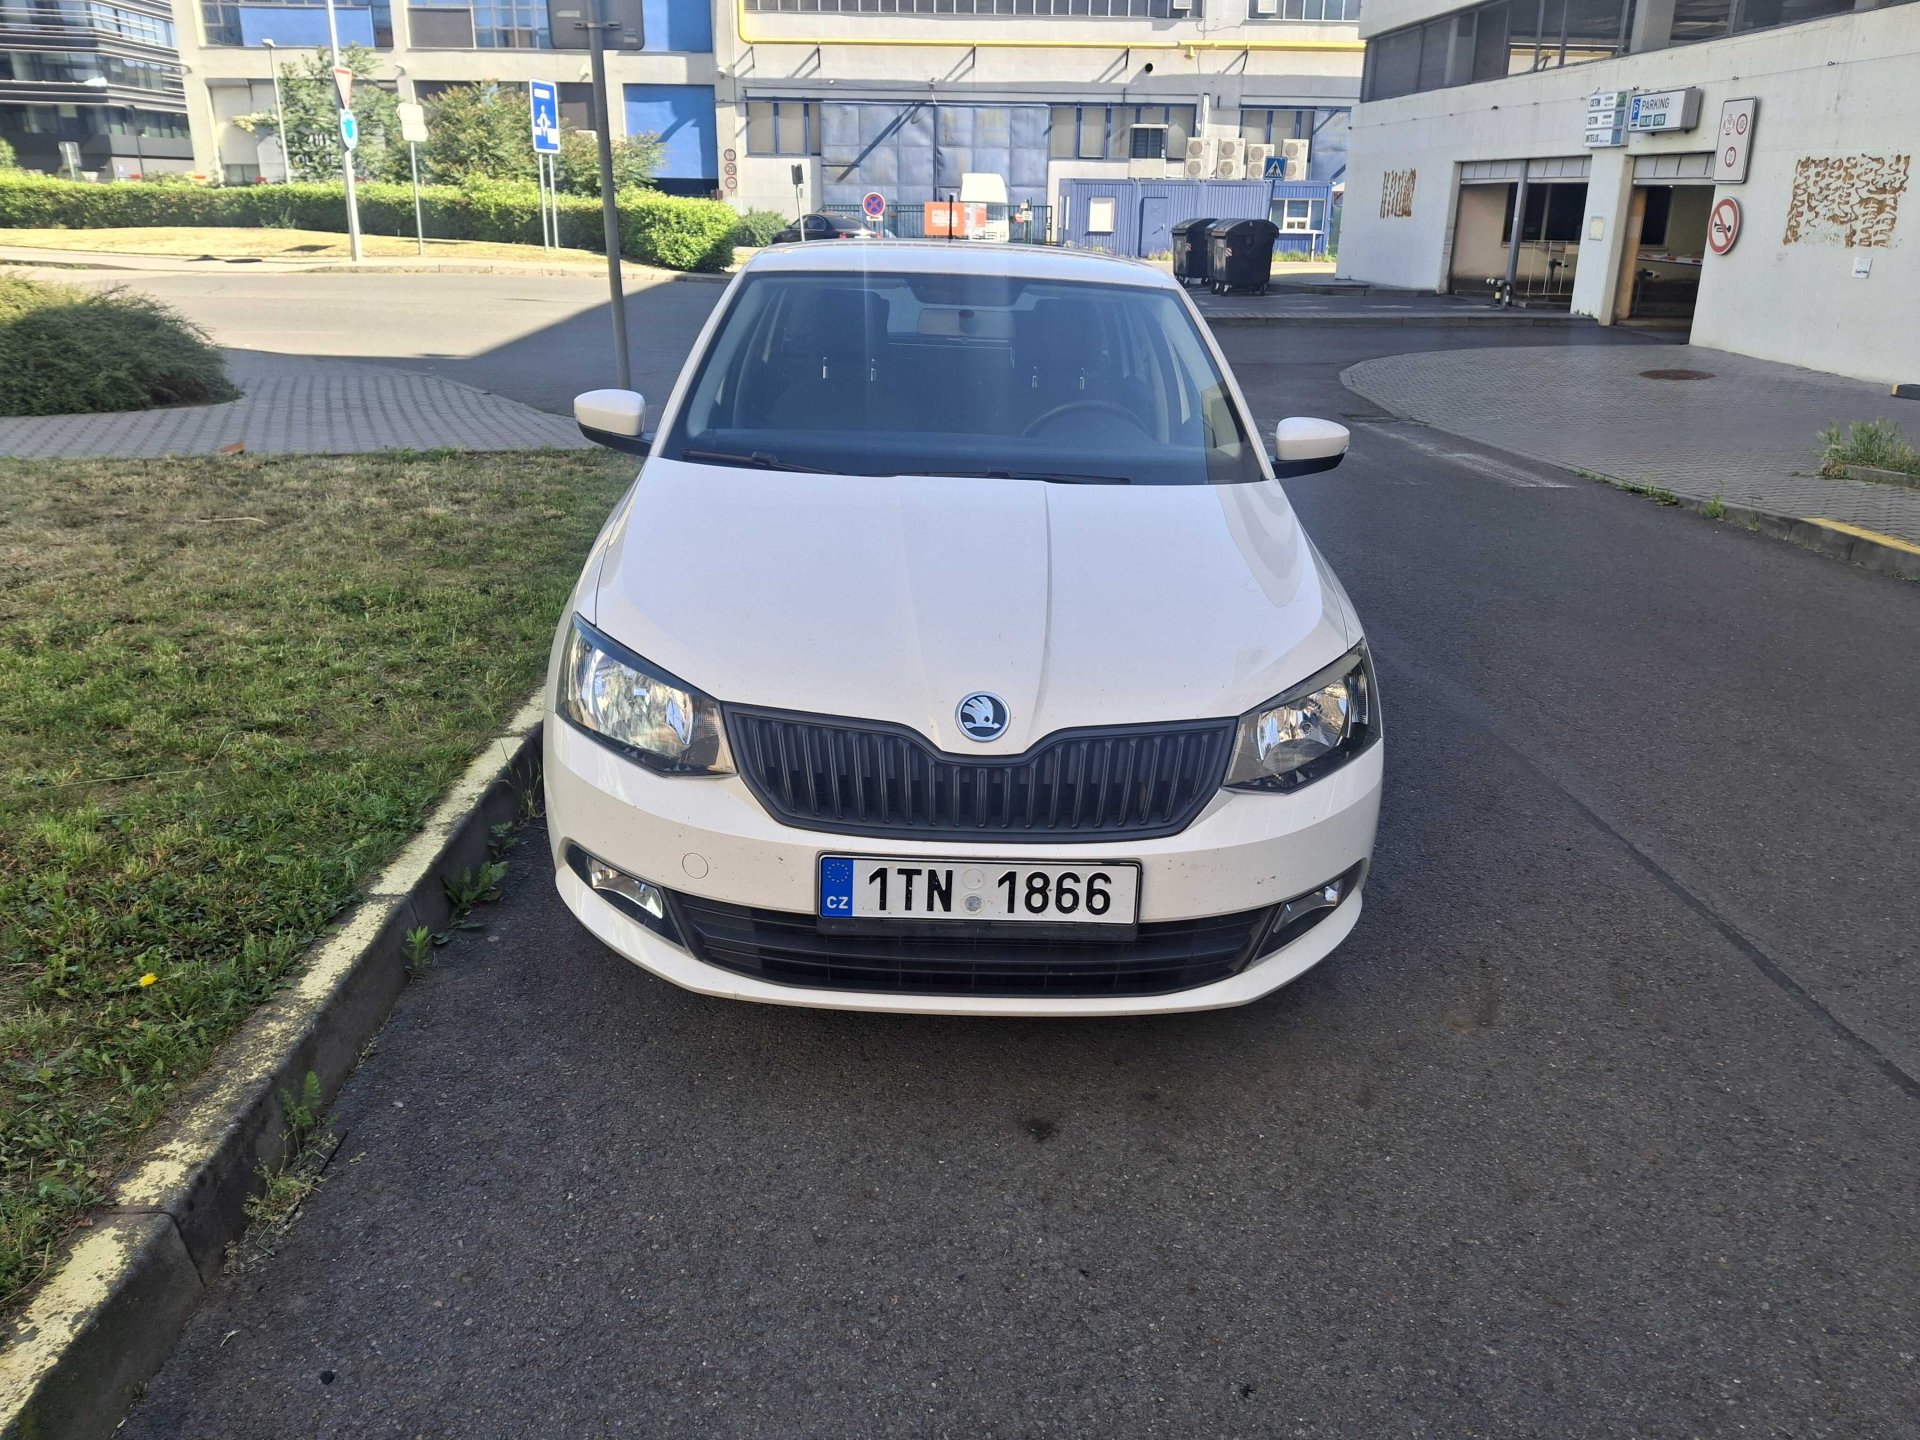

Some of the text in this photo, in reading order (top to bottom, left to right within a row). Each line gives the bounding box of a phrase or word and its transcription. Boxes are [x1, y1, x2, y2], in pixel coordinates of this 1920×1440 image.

[1641, 98, 1670, 110] PARKING
[868, 867, 1112, 915] 1TN 1866
[826, 895, 849, 910] CZ
